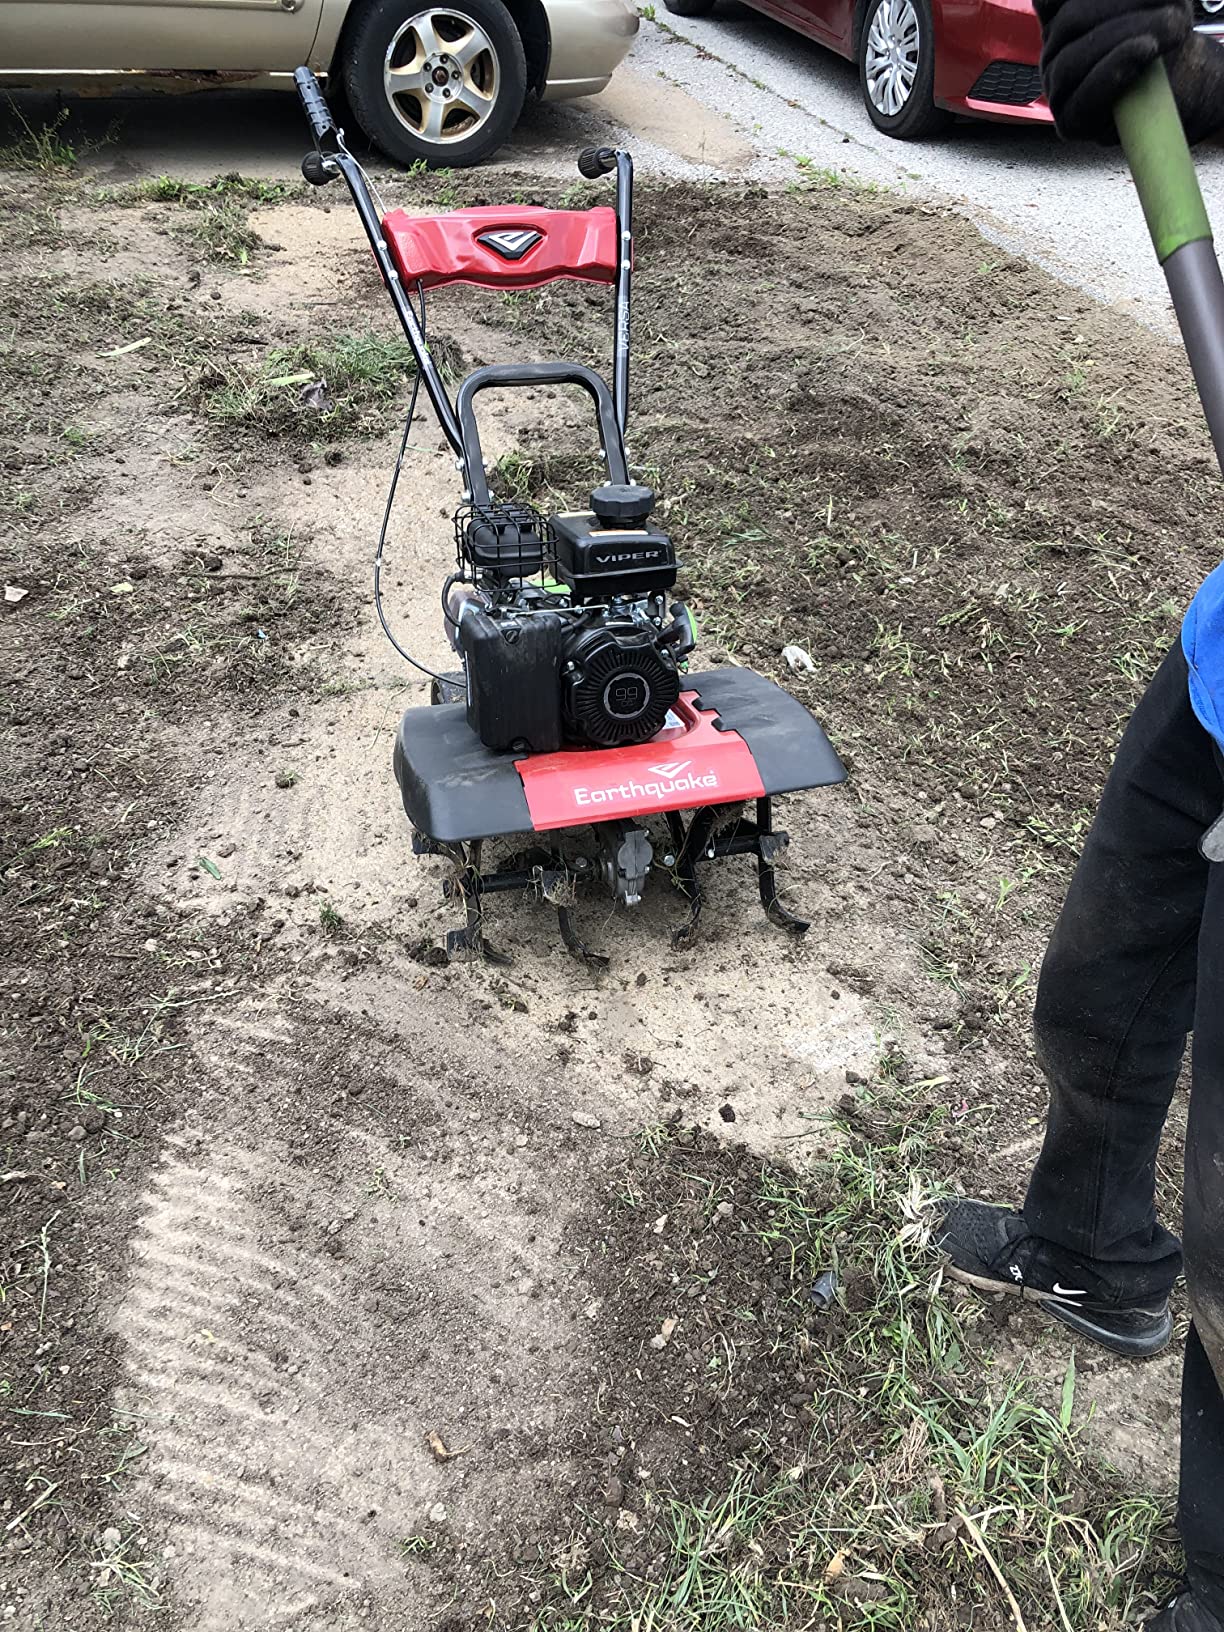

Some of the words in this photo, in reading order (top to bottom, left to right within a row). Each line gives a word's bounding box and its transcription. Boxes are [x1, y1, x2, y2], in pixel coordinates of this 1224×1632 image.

[617, 301, 630, 350] VERSA
[595, 550, 660, 563] VIPER
[615, 687, 638, 701] 99
[573, 772, 718, 805] Earthquake
